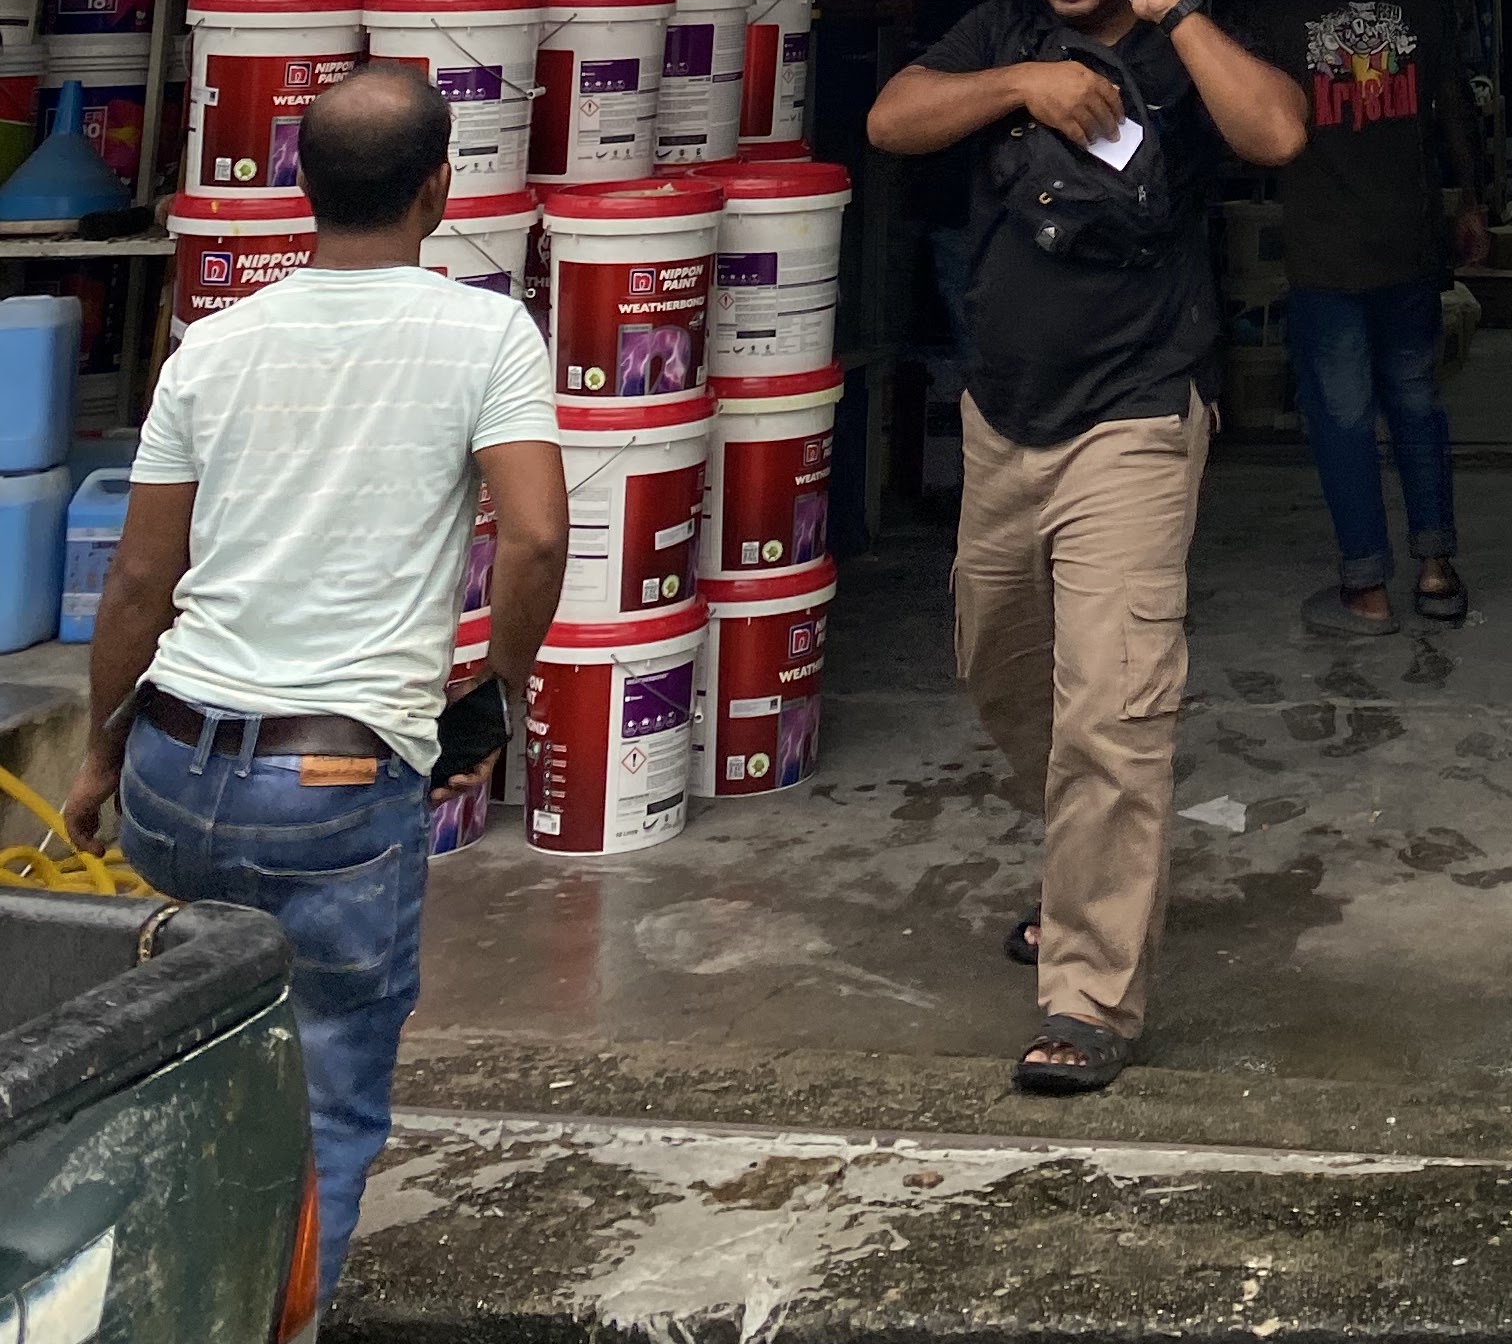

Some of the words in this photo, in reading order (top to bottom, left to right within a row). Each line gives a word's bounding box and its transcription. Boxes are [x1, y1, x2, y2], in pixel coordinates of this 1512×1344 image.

[235, 250, 311, 269] NIPPON
[659, 264, 704, 280] NIPPON
[662, 277, 699, 291] PAINT
[618, 295, 705, 314] WEATHERBOND
